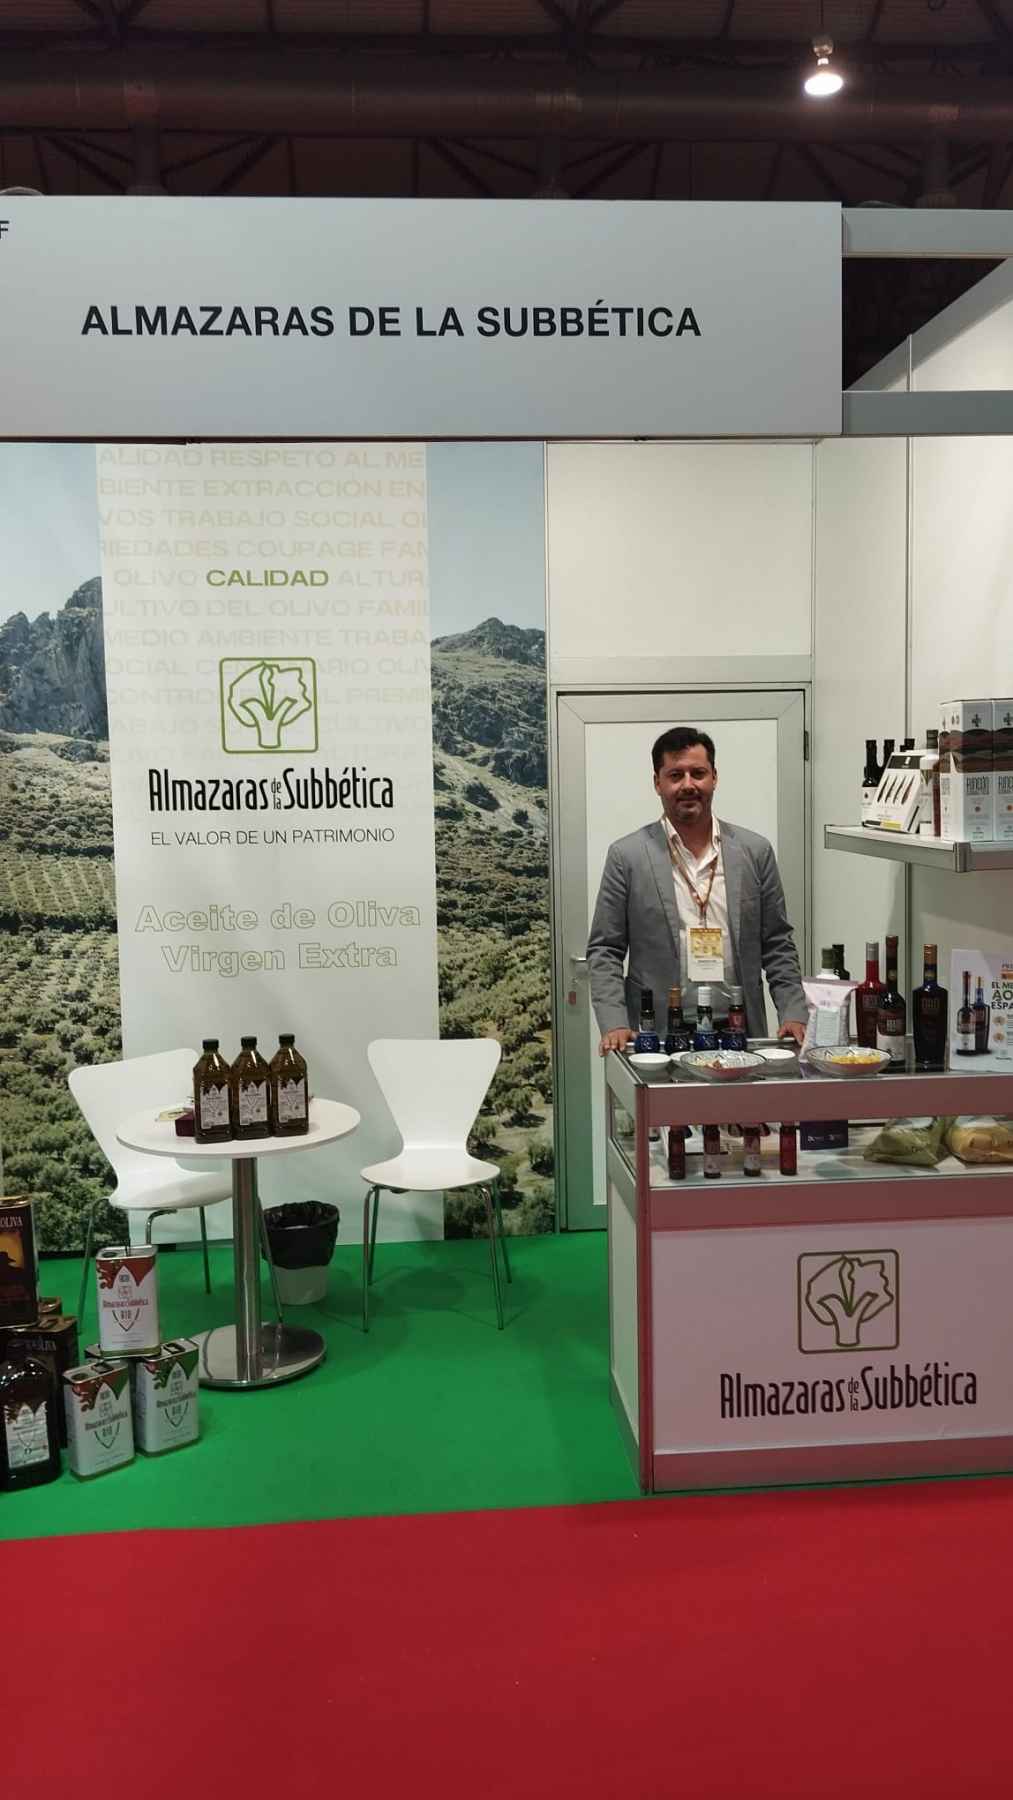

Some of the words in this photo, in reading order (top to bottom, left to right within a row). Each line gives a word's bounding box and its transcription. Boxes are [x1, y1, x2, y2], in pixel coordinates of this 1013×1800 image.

[82, 305, 334, 337] ALMAZARAS
[348, 306, 401, 337] DE
[415, 307, 464, 337] LA
[477, 300, 702, 338] SUBBÉTICA
[99, 448, 201, 467] ALIDAD
[210, 448, 336, 468] RESPETO
[343, 450, 381, 468] AL
[99, 478, 201, 497] BIENTE
[161, 508, 286, 528] TRABAJO
[294, 510, 393, 528] SOCIAL
[236, 540, 377, 558] COUPAGE
[113, 568, 198, 586] OLIVO
[206, 569, 330, 587] CALIDAD
[207, 600, 264, 617] DEL
[268, 600, 351, 617] OLIVO
[198, 630, 333, 649] AMBIENTE
[149, 768, 268, 812] Almazaras
[271, 777, 282, 794] de
[282, 767, 394, 810] Subbética
[272, 795, 282, 810] la
[151, 831, 171, 846] EL
[175, 830, 231, 846] VALOR
[236, 830, 259, 845] DE
[263, 829, 288, 845] UN
[292, 827, 395, 844] PATRIMONIO
[135, 904, 259, 933] Aceite
[270, 902, 316, 930] de
[327, 900, 421, 929] Oliva
[161, 945, 286, 978] Virgen
[298, 942, 398, 970] Extra
[848, 1377, 859, 1394] de
[860, 1361, 977, 1412] Subbética
[720, 1372, 845, 1419] Almazaras
[850, 1396, 859, 1412] la
